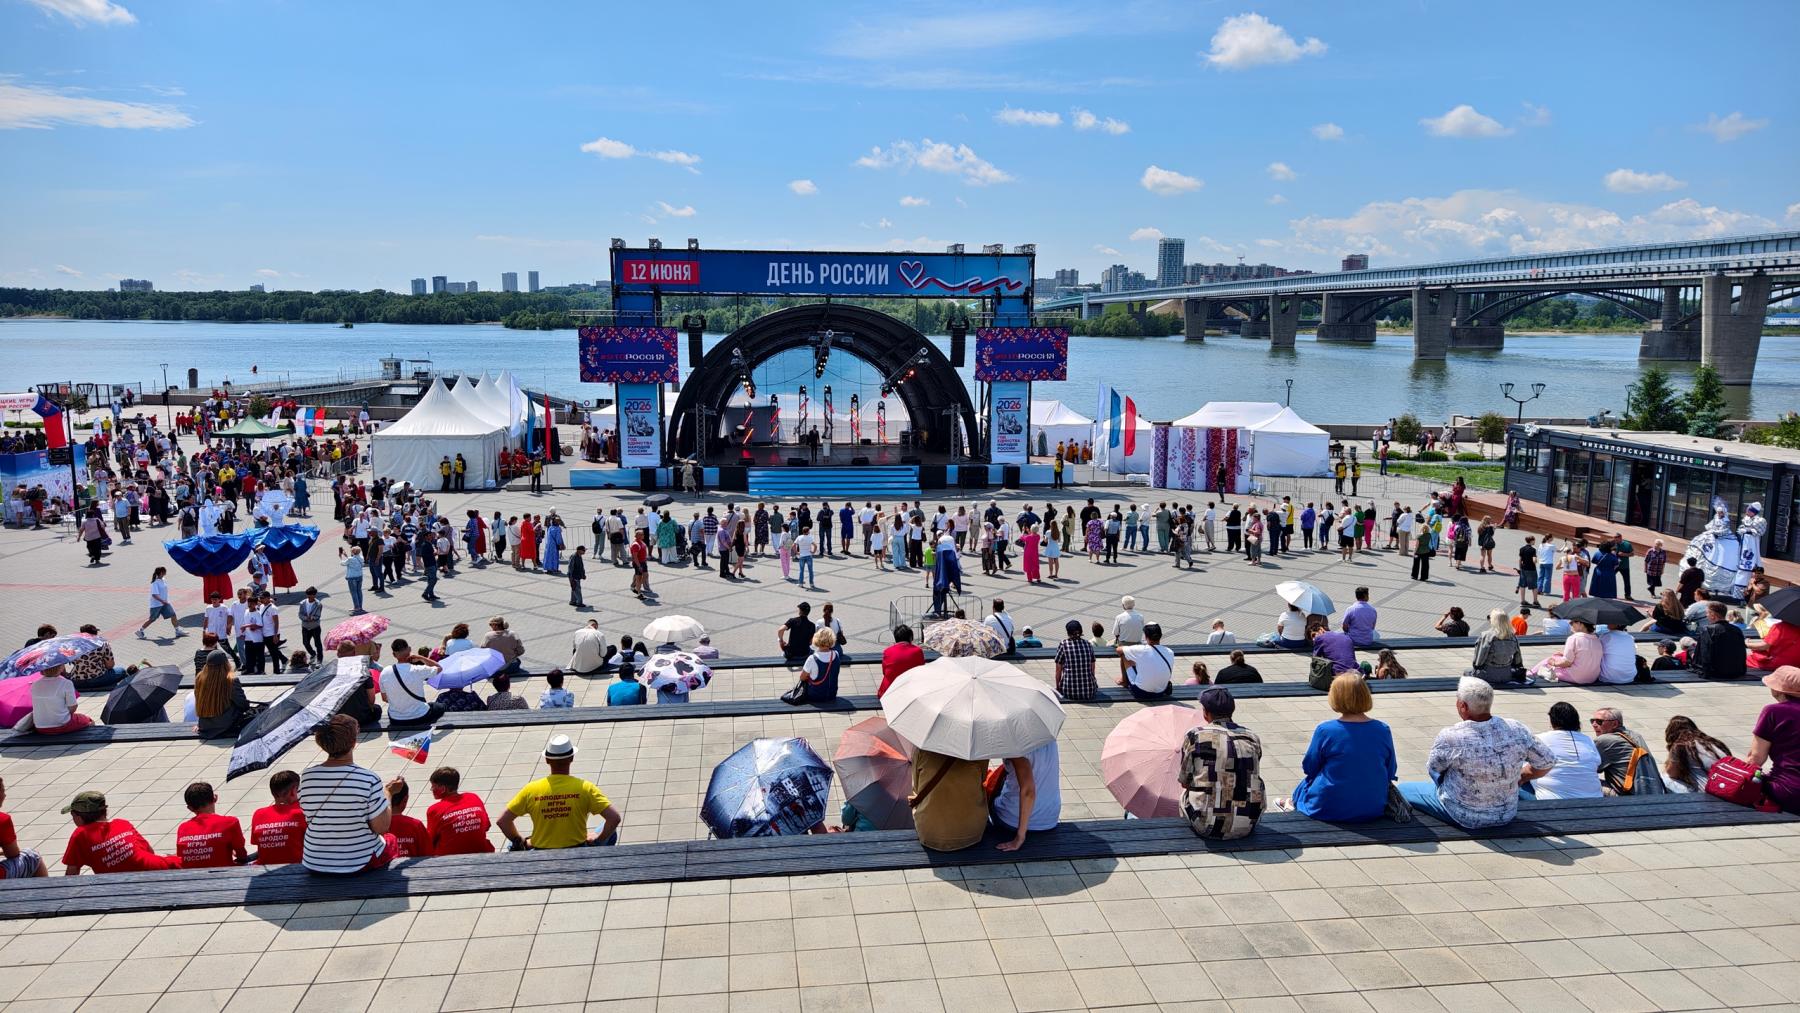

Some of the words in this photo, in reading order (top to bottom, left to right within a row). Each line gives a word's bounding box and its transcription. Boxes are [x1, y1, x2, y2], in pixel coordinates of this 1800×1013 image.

[631, 263, 647, 281] 12
[650, 264, 691, 281] ИЮНЯ
[766, 262, 814, 286] ДЕНЬ
[820, 263, 889, 285] РОССИИ
[626, 401, 651, 410] 2026
[998, 400, 1022, 410] 2026
[534, 793, 581, 801] МОЛОДЕЦКИЕ
[541, 806, 572, 814] НАРОДОВ
[105, 839, 126, 853] ИГРЫ
[101, 843, 134, 863] НАРОДОВ
[106, 850, 134, 868] РОССИИ
[183, 853, 211, 861] РОССИИ
